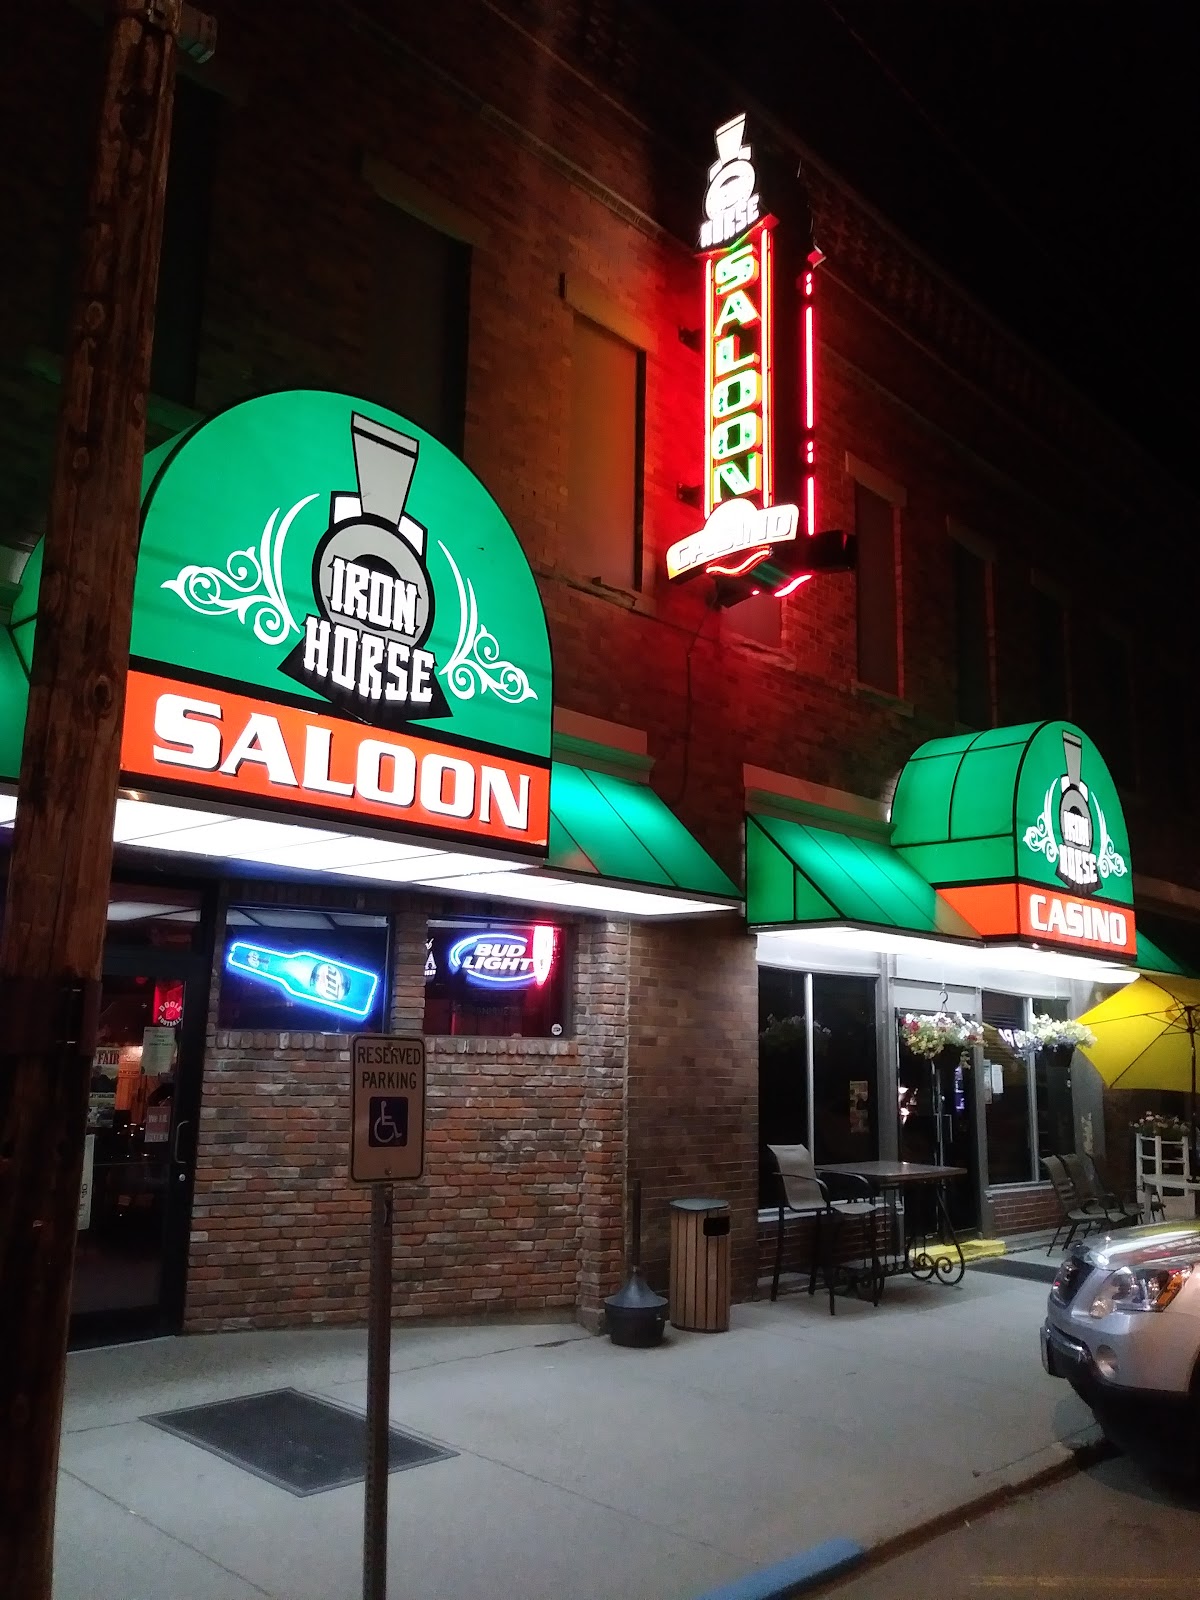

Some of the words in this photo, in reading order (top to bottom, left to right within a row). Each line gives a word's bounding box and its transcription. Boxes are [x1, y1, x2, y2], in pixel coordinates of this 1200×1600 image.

[712, 245, 762, 503] SALOON
[330, 556, 419, 634] IRON
[302, 615, 436, 704] HORSE
[152, 693, 531, 831] SALOON
[1063, 811, 1090, 846] IRON
[1058, 844, 1098, 885] HORSE
[1029, 894, 1127, 946] CASINO
[461, 956, 536, 972] LIGHT
[473, 942, 527, 958] BUD
[97, 1053, 119, 1065] FAIR
[357, 1047, 421, 1065] RESERVED
[361, 1070, 417, 1090] PARKING
